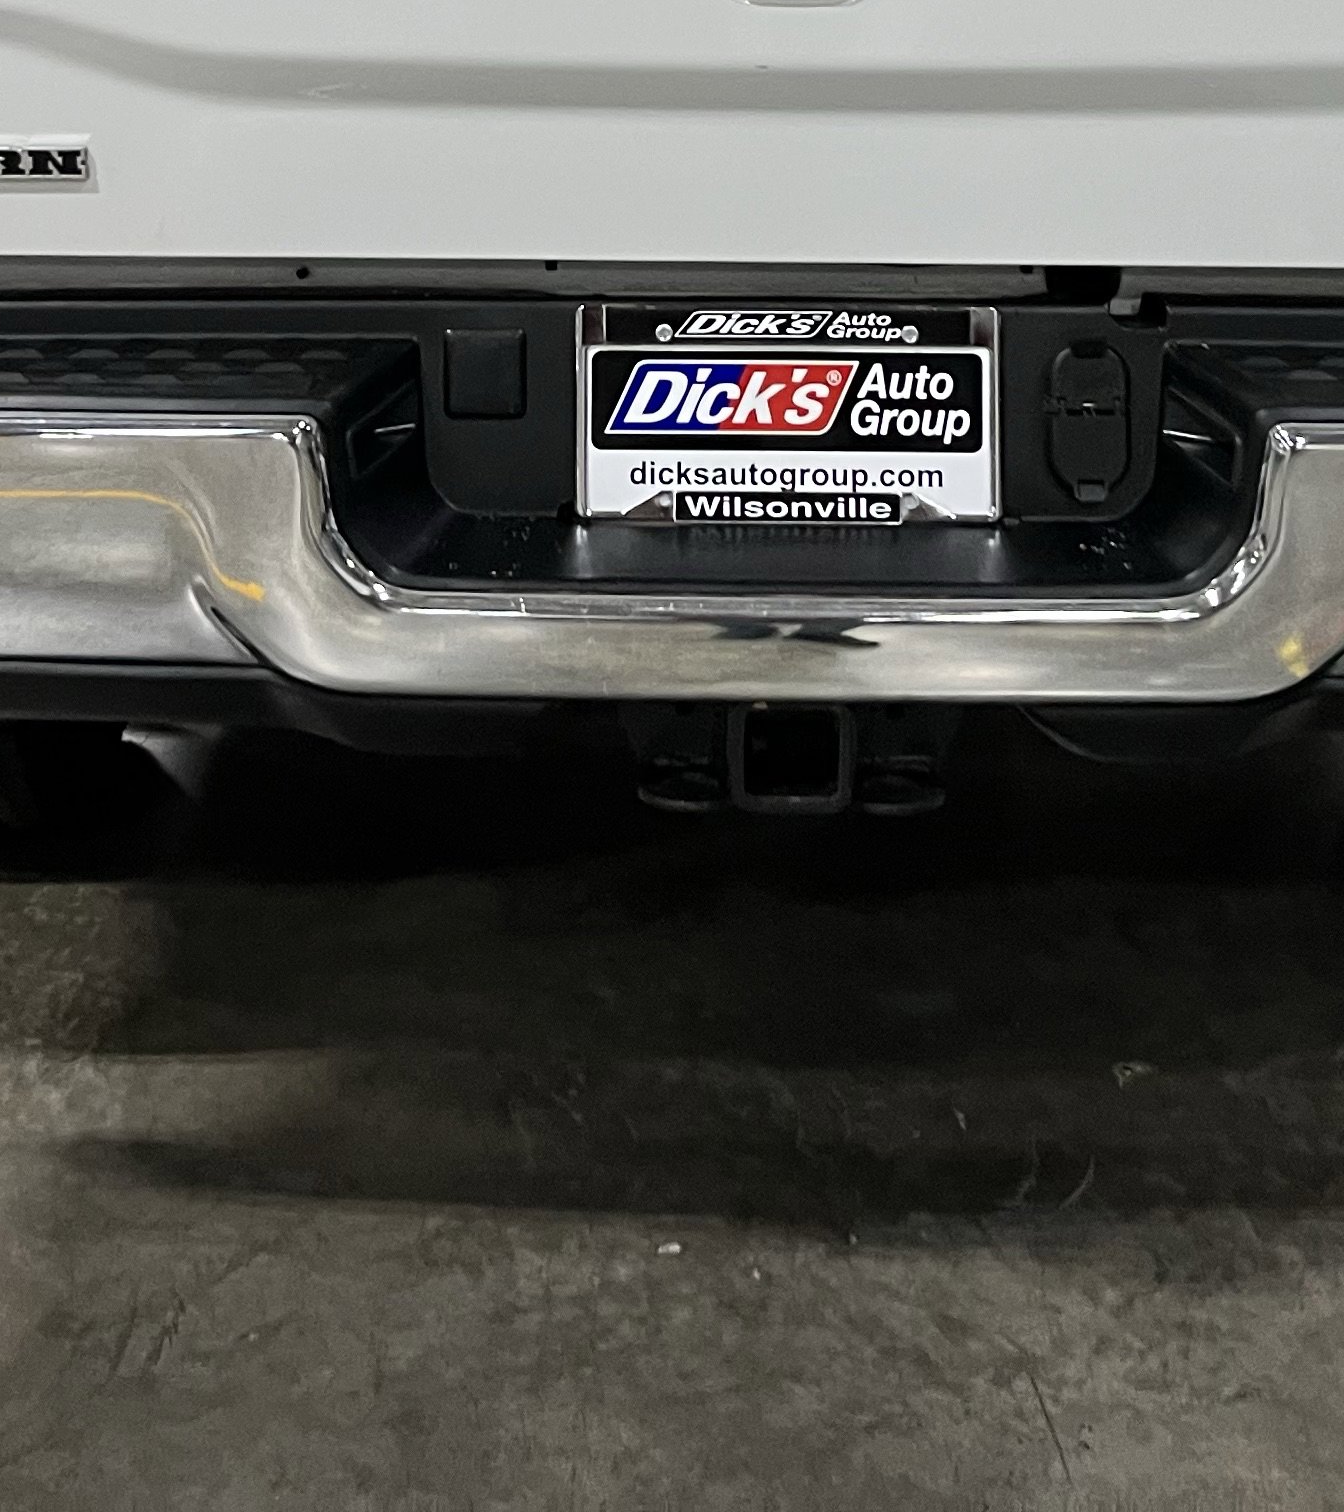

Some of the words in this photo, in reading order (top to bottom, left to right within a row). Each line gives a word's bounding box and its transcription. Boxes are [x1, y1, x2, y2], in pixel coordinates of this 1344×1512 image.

[684, 311, 816, 335] Dick's
[835, 310, 892, 326] Auto
[826, 324, 903, 342] Group
[857, 362, 954, 401] Auto
[623, 367, 830, 426] Dick's
[850, 399, 971, 445] Group
[629, 461, 944, 492] dicksautogroup.com
[683, 495, 892, 519] Wilsonville
